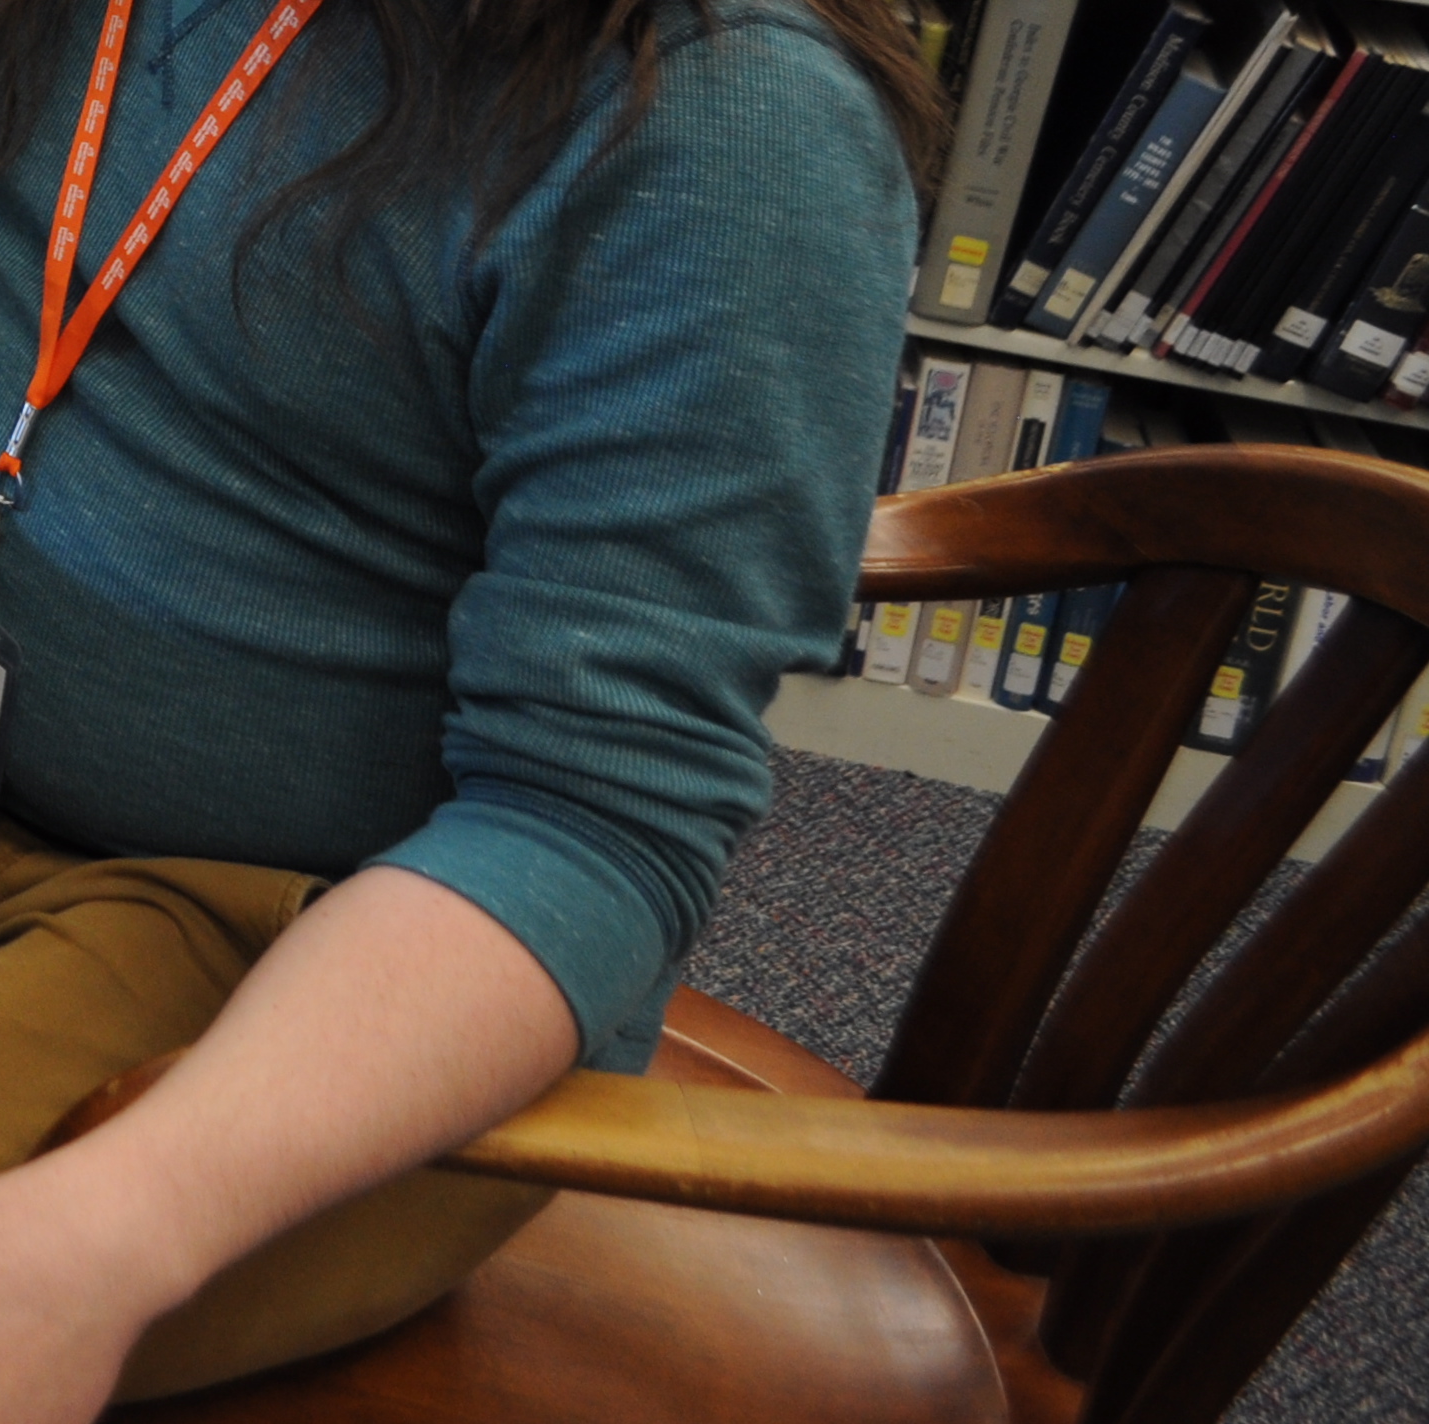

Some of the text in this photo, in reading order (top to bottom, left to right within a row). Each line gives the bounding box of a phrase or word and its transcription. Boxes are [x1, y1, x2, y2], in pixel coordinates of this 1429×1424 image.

[1048, 32, 1184, 244] Madison County Cemetery Book
